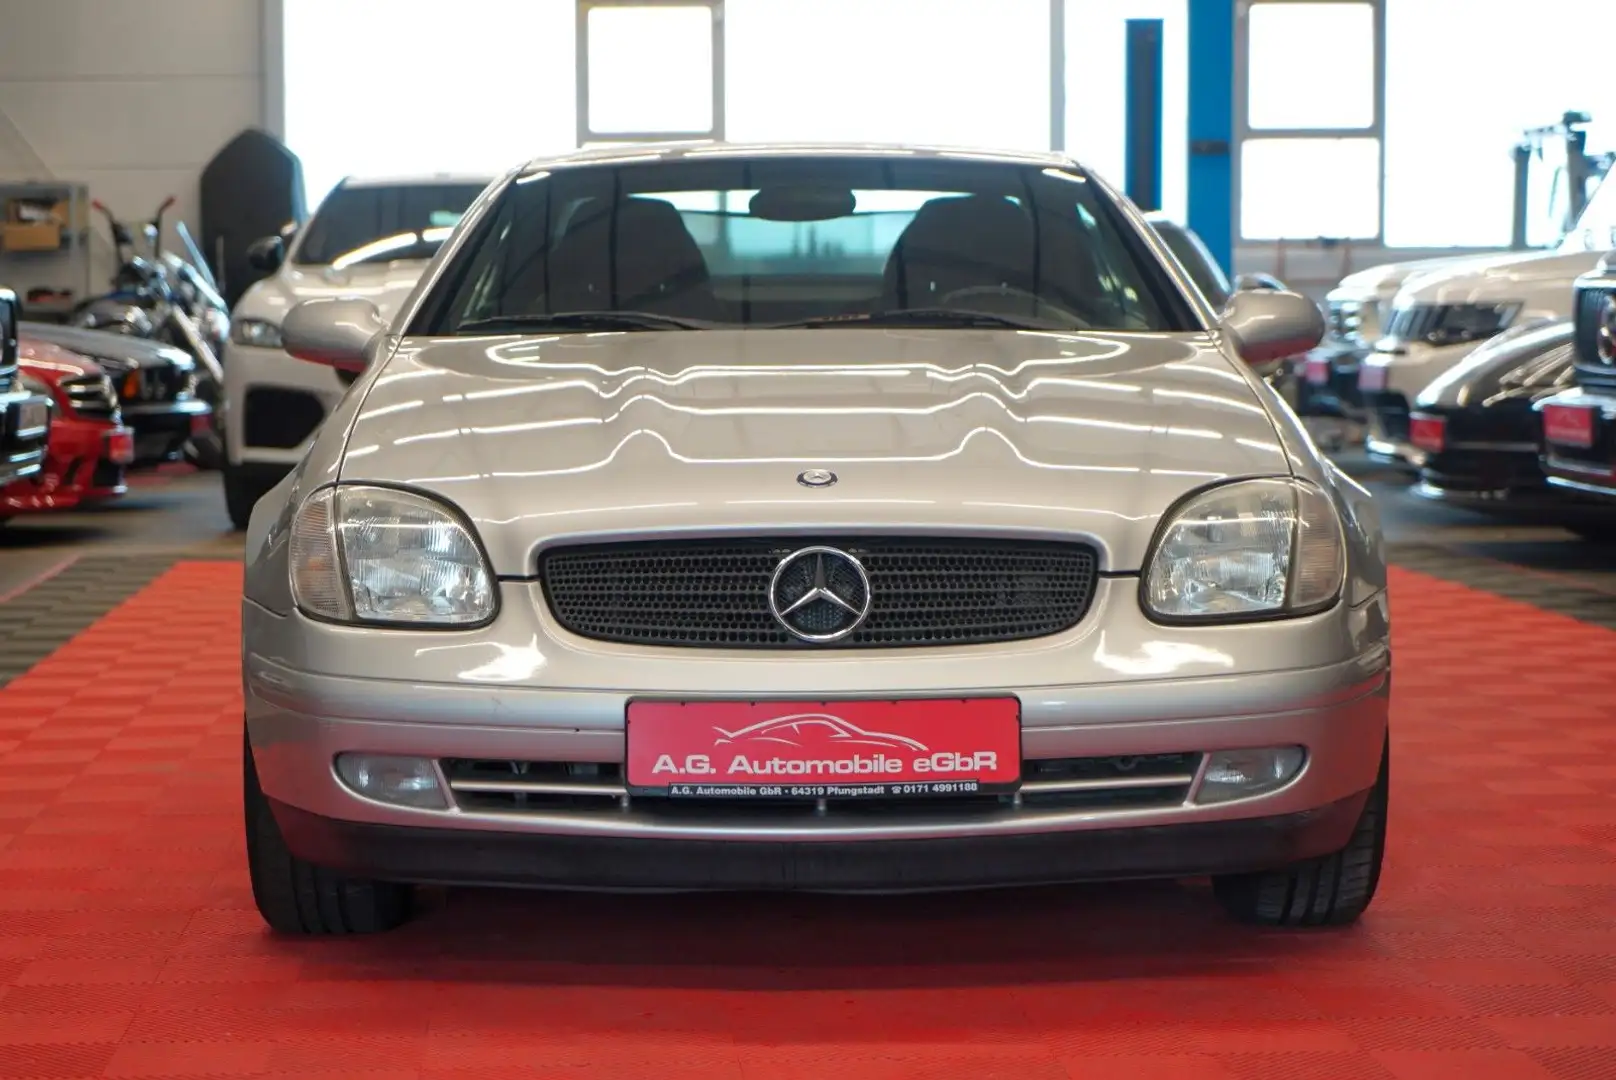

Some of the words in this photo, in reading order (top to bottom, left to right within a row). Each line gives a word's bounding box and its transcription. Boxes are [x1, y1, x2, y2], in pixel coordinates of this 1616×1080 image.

[652, 754, 717, 775] A.G.
[727, 754, 903, 775] Automobile
[913, 751, 997, 773] eGbR
[671, 786, 693, 795] A.G.
[696, 786, 757, 796] Automobile
[759, 786, 782, 796] GbR
[791, 786, 824, 796] 64319
[826, 785, 885, 797] Pfungstadt
[903, 784, 929, 794] 0171
